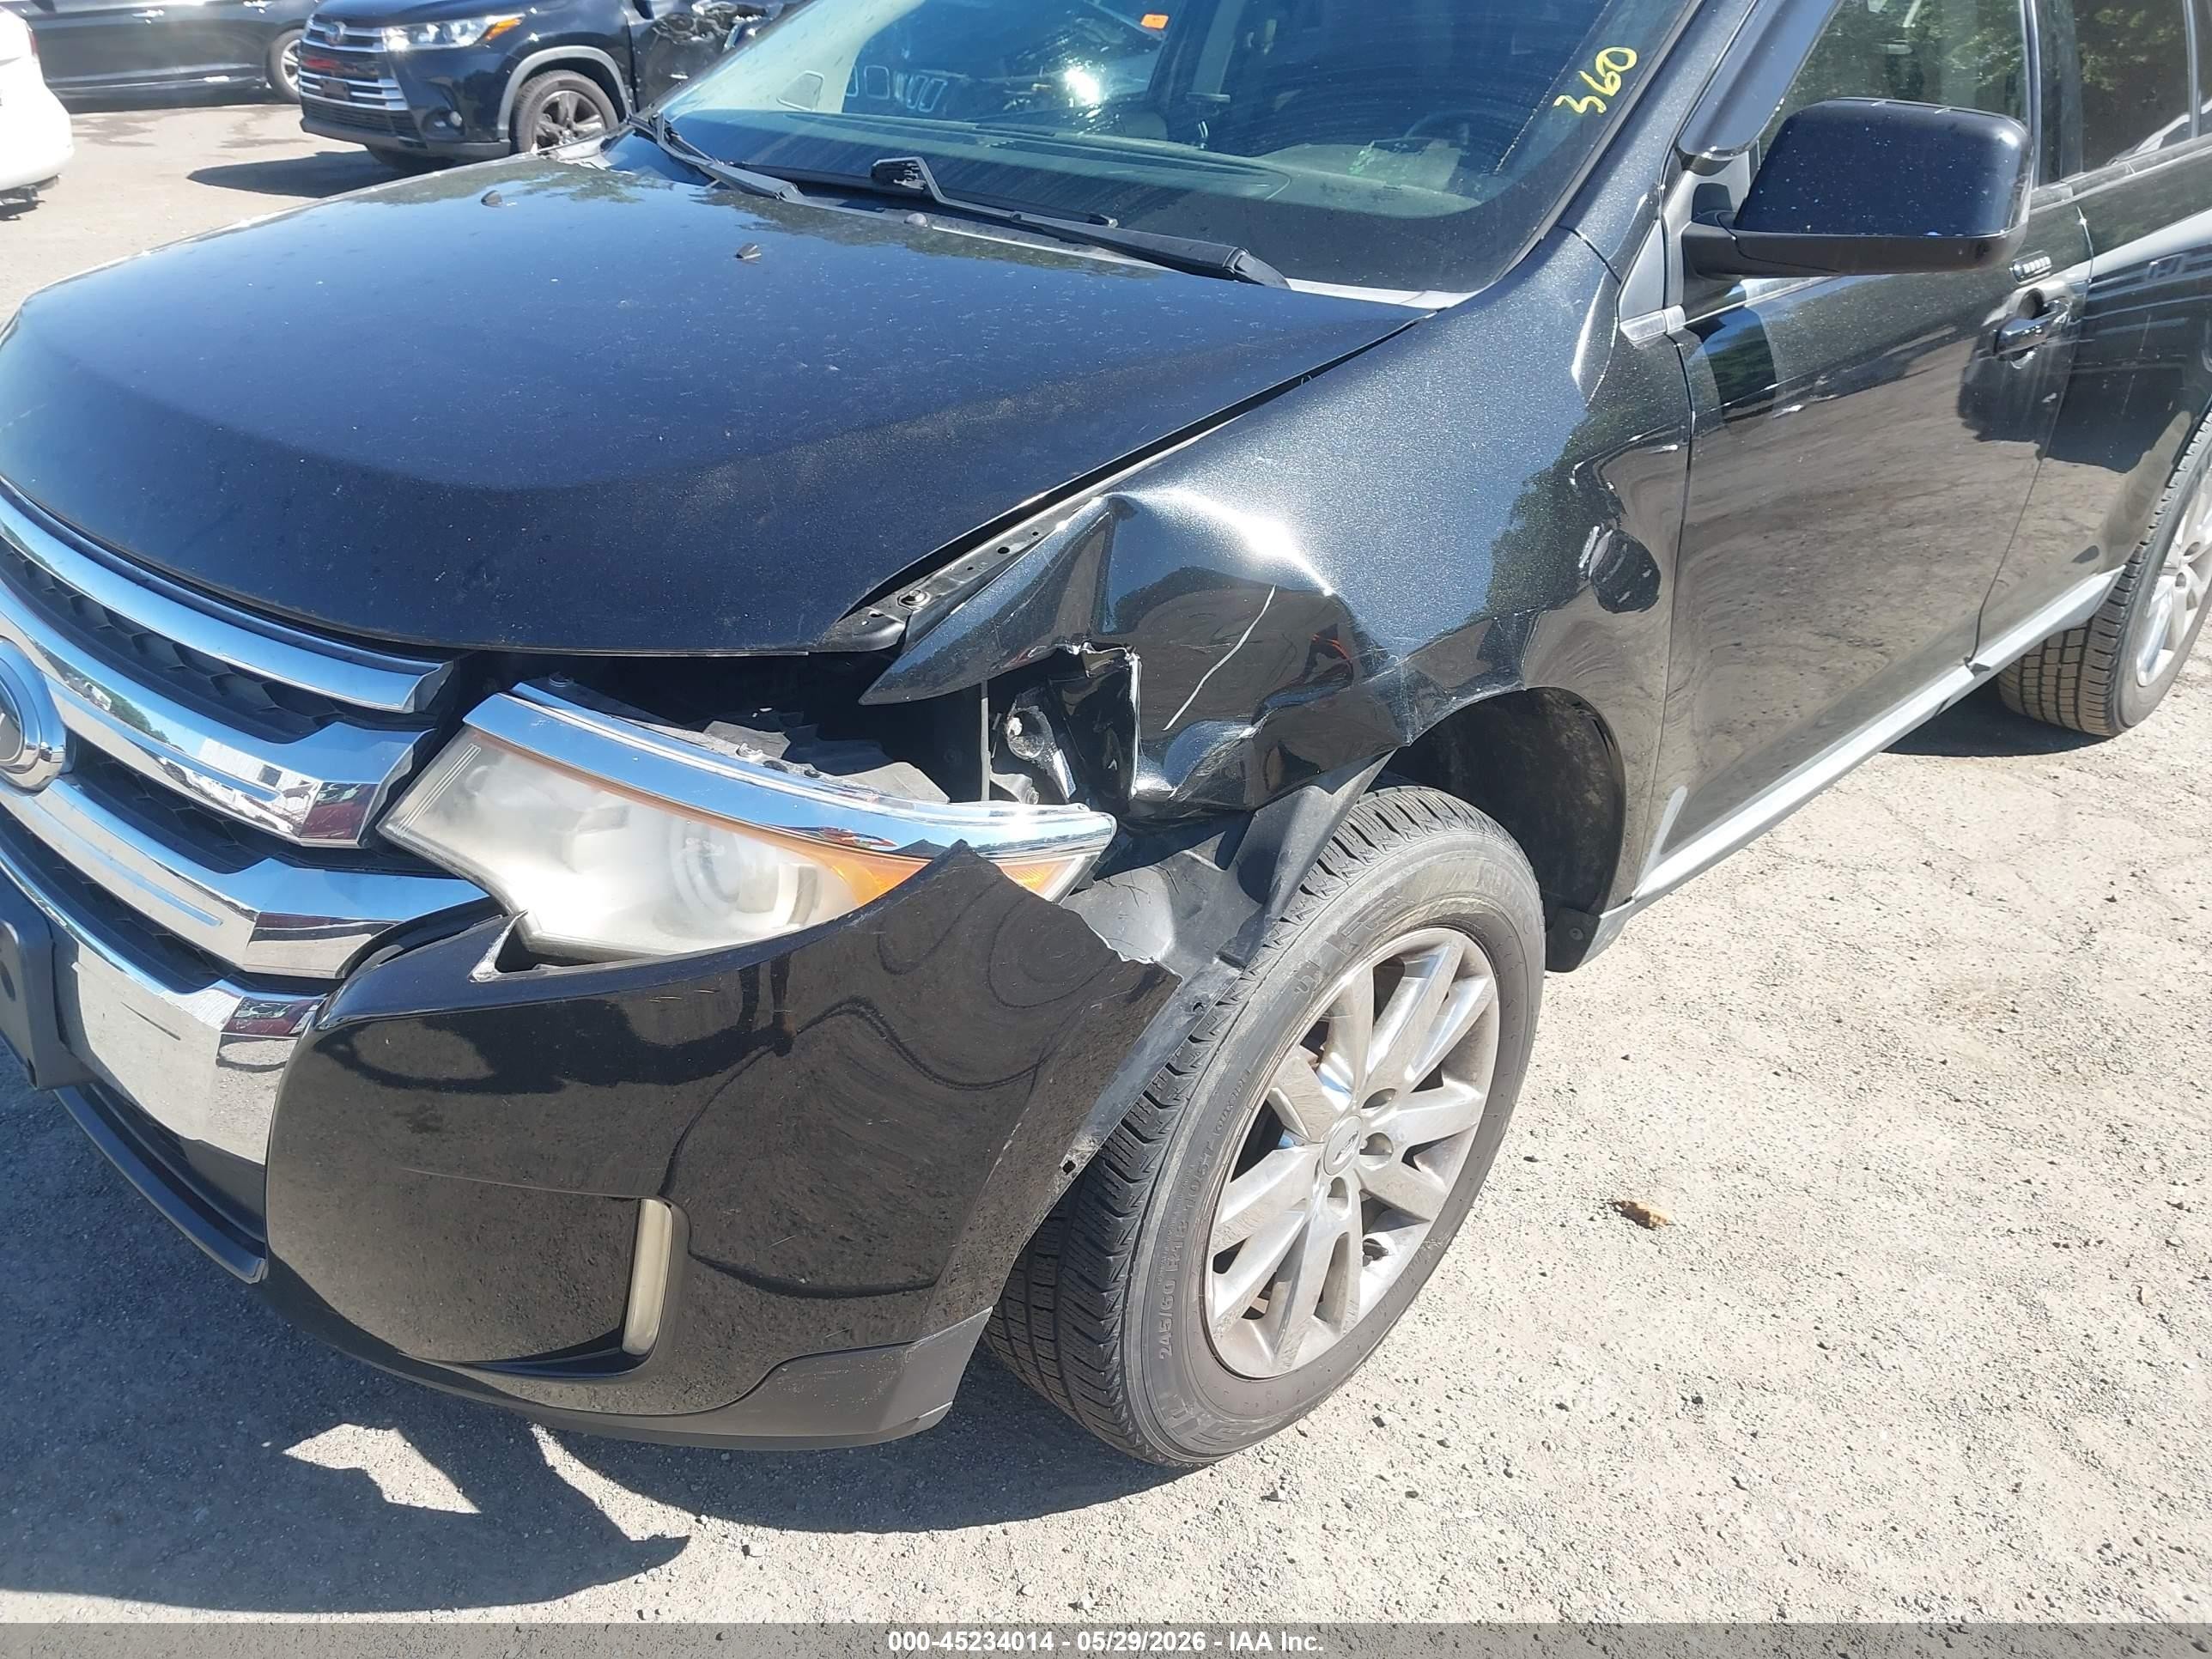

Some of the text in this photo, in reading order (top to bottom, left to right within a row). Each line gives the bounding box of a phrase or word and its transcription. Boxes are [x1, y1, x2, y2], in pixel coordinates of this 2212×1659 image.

[1552, 46, 1638, 114] 360
[1158, 1279, 1176, 1360] 245/60
[1167, 1219, 1189, 1273] R18
